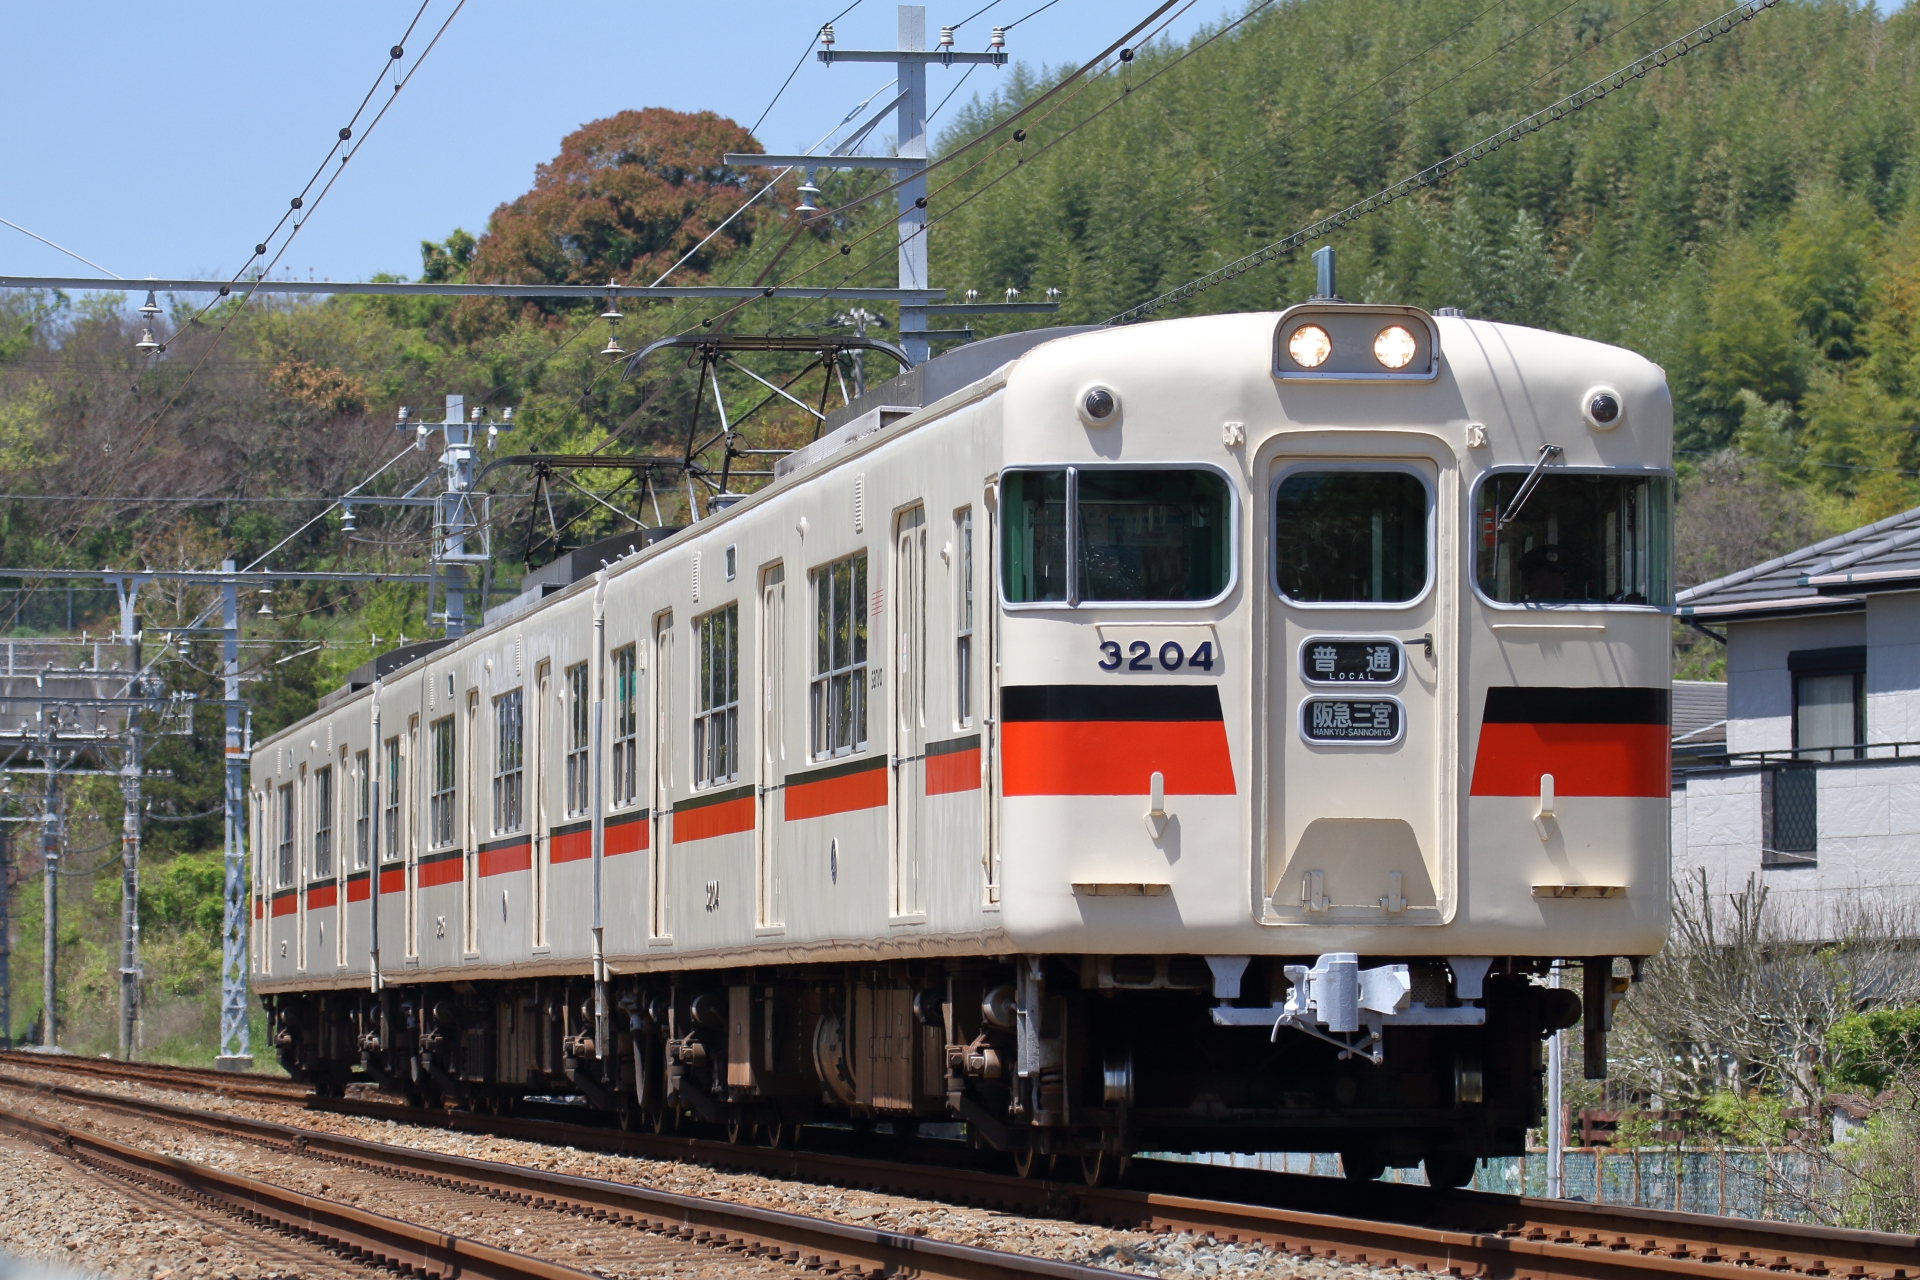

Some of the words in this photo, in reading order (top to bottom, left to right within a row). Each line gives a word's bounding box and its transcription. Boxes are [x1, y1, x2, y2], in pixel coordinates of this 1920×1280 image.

[1098, 640, 1213, 671] 3204
[1313, 646, 1391, 672] 普通
[1313, 702, 1391, 728] 阪急三宮
